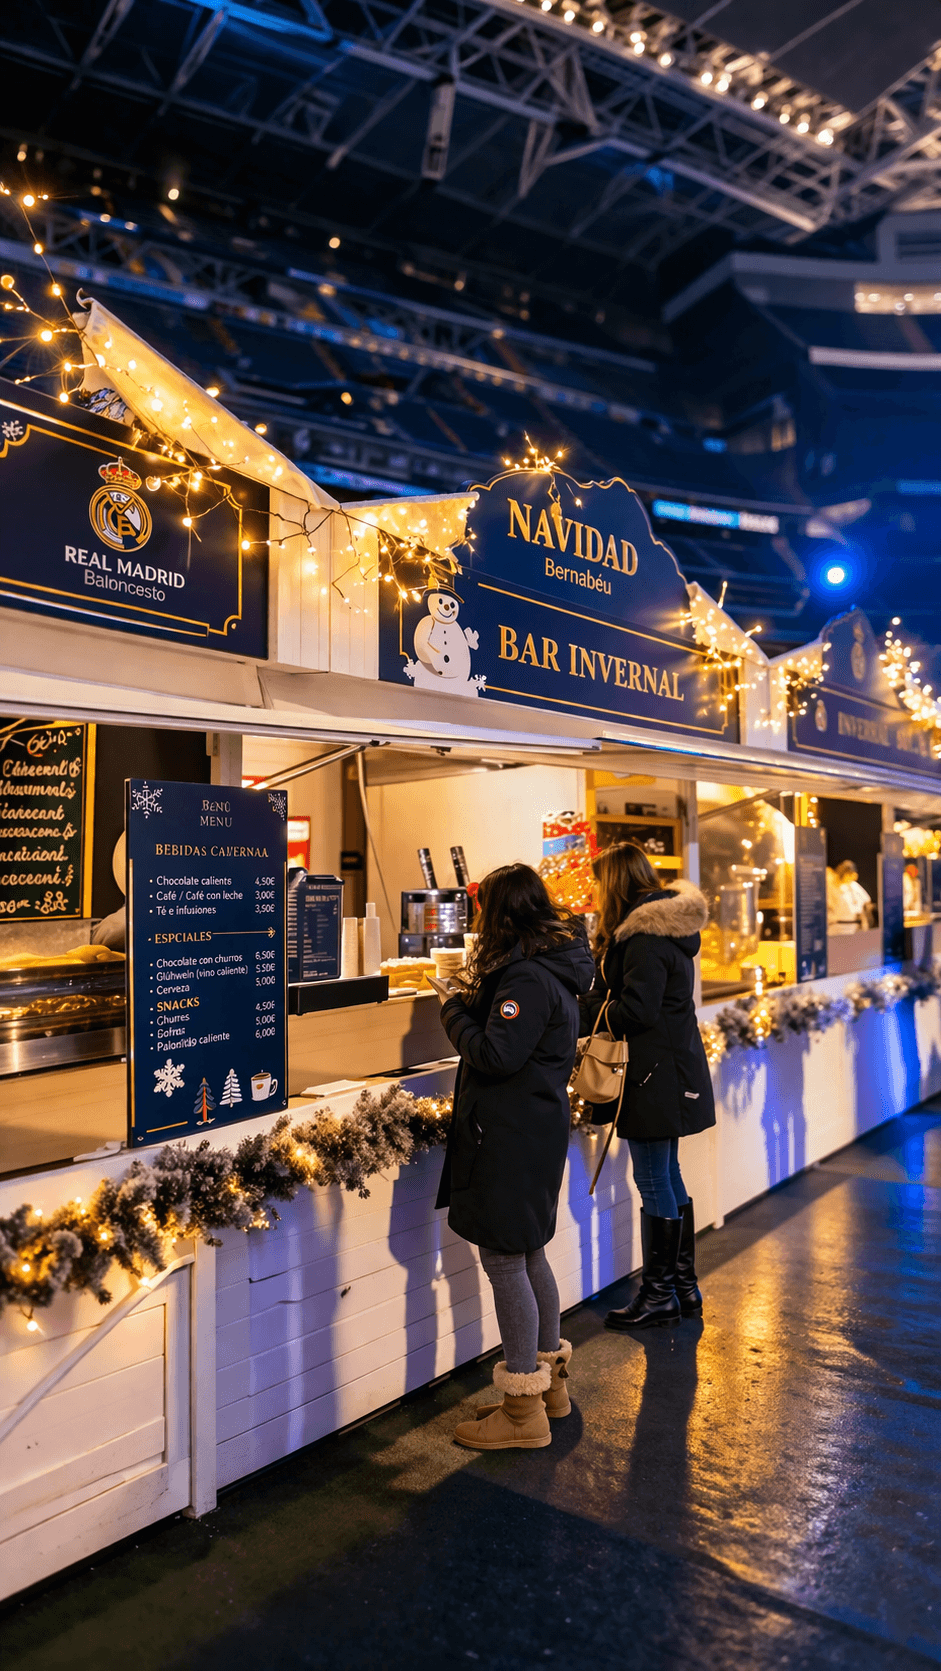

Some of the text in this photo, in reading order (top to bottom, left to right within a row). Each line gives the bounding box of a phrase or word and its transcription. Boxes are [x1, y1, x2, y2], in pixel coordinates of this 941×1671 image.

[507, 498, 638, 576] NAVIDAD
[65, 545, 185, 588] REAL MADRID
[545, 557, 611, 595] Bernabéu
[84, 569, 166, 601] Baloncesto
[498, 624, 684, 701] BAR INVERNAL
[156, 844, 207, 856] BEBIDAS
[255, 877, 275, 886] 4,50€
[156, 891, 176, 901] Café
[186, 891, 204, 901] Café
[223, 891, 243, 900] leche
[255, 890, 275, 900] 3,00€
[156, 906, 166, 916] Té
[155, 931, 212, 944] ESPCIALES
[156, 957, 197, 968] Chocolate
[199, 957, 213, 965] con
[215, 954, 243, 963] churros
[197, 969, 215, 979] (vino
[217, 965, 248, 976] caliente)
[156, 985, 190, 995] Cerveza
[157, 997, 200, 1012] SNACKS
[199, 1032, 230, 1045] caliente
